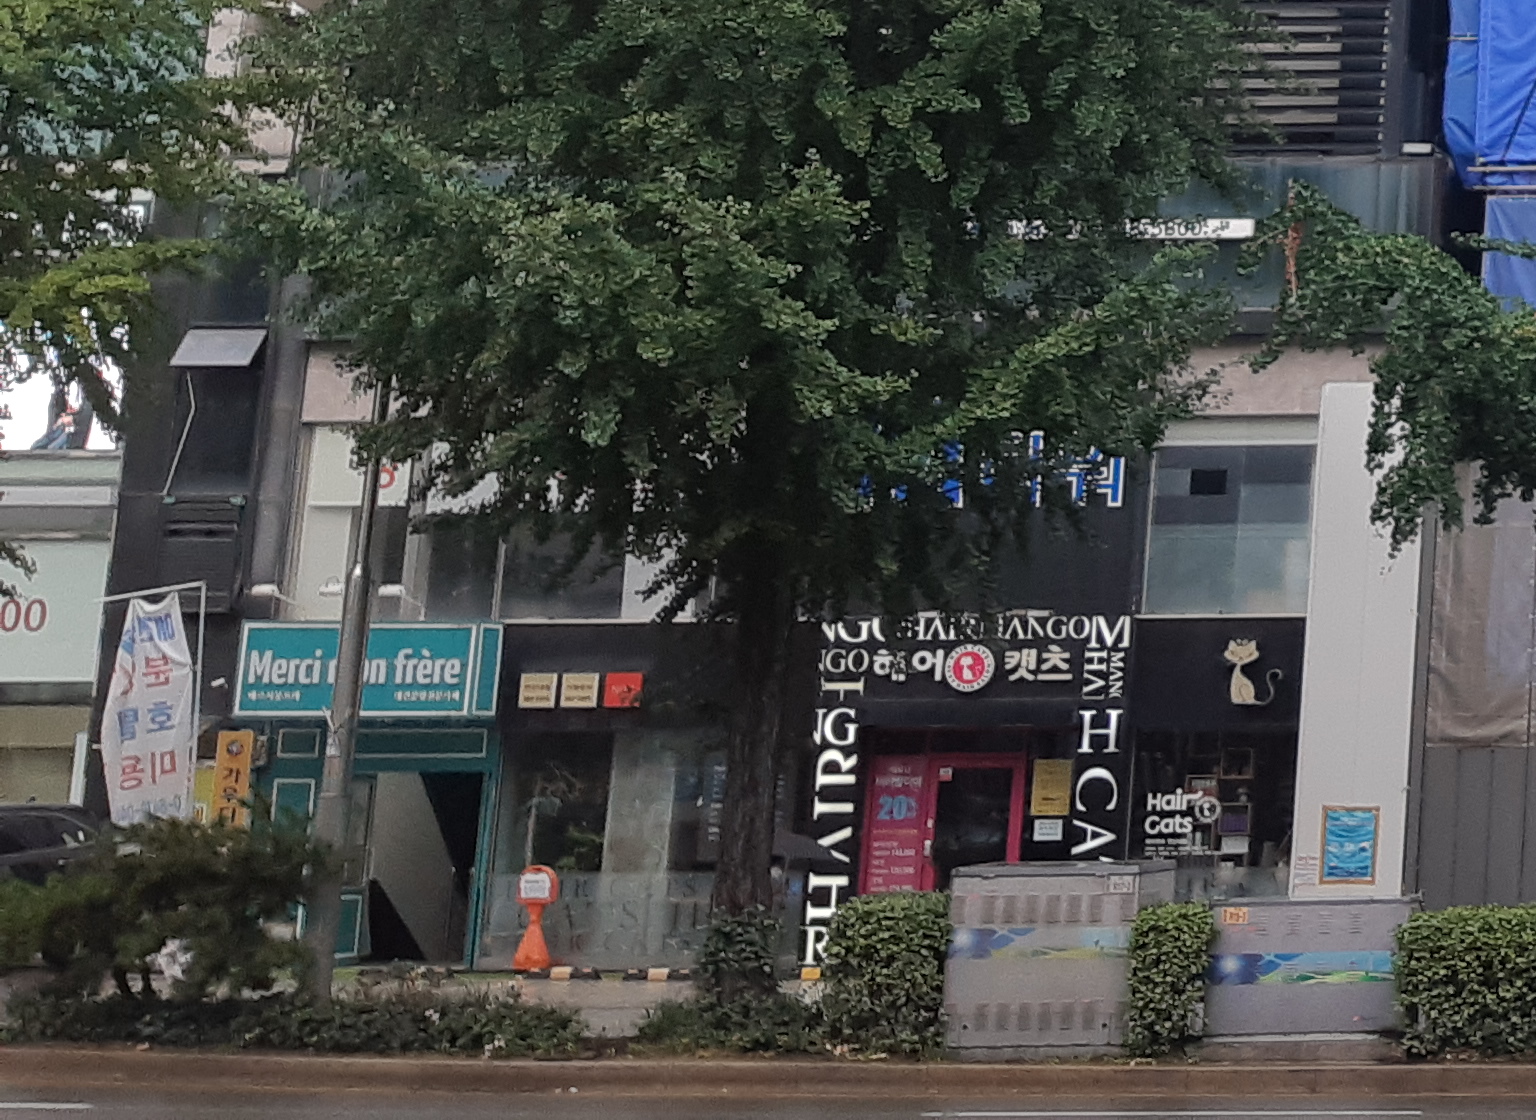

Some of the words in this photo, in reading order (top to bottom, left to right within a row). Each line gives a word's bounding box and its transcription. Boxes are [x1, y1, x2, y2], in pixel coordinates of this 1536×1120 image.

[247, 648, 322, 685] Merci
[393, 648, 462, 685] frère
[1147, 788, 1202, 812] Hair
[1144, 814, 1194, 835] Cats
